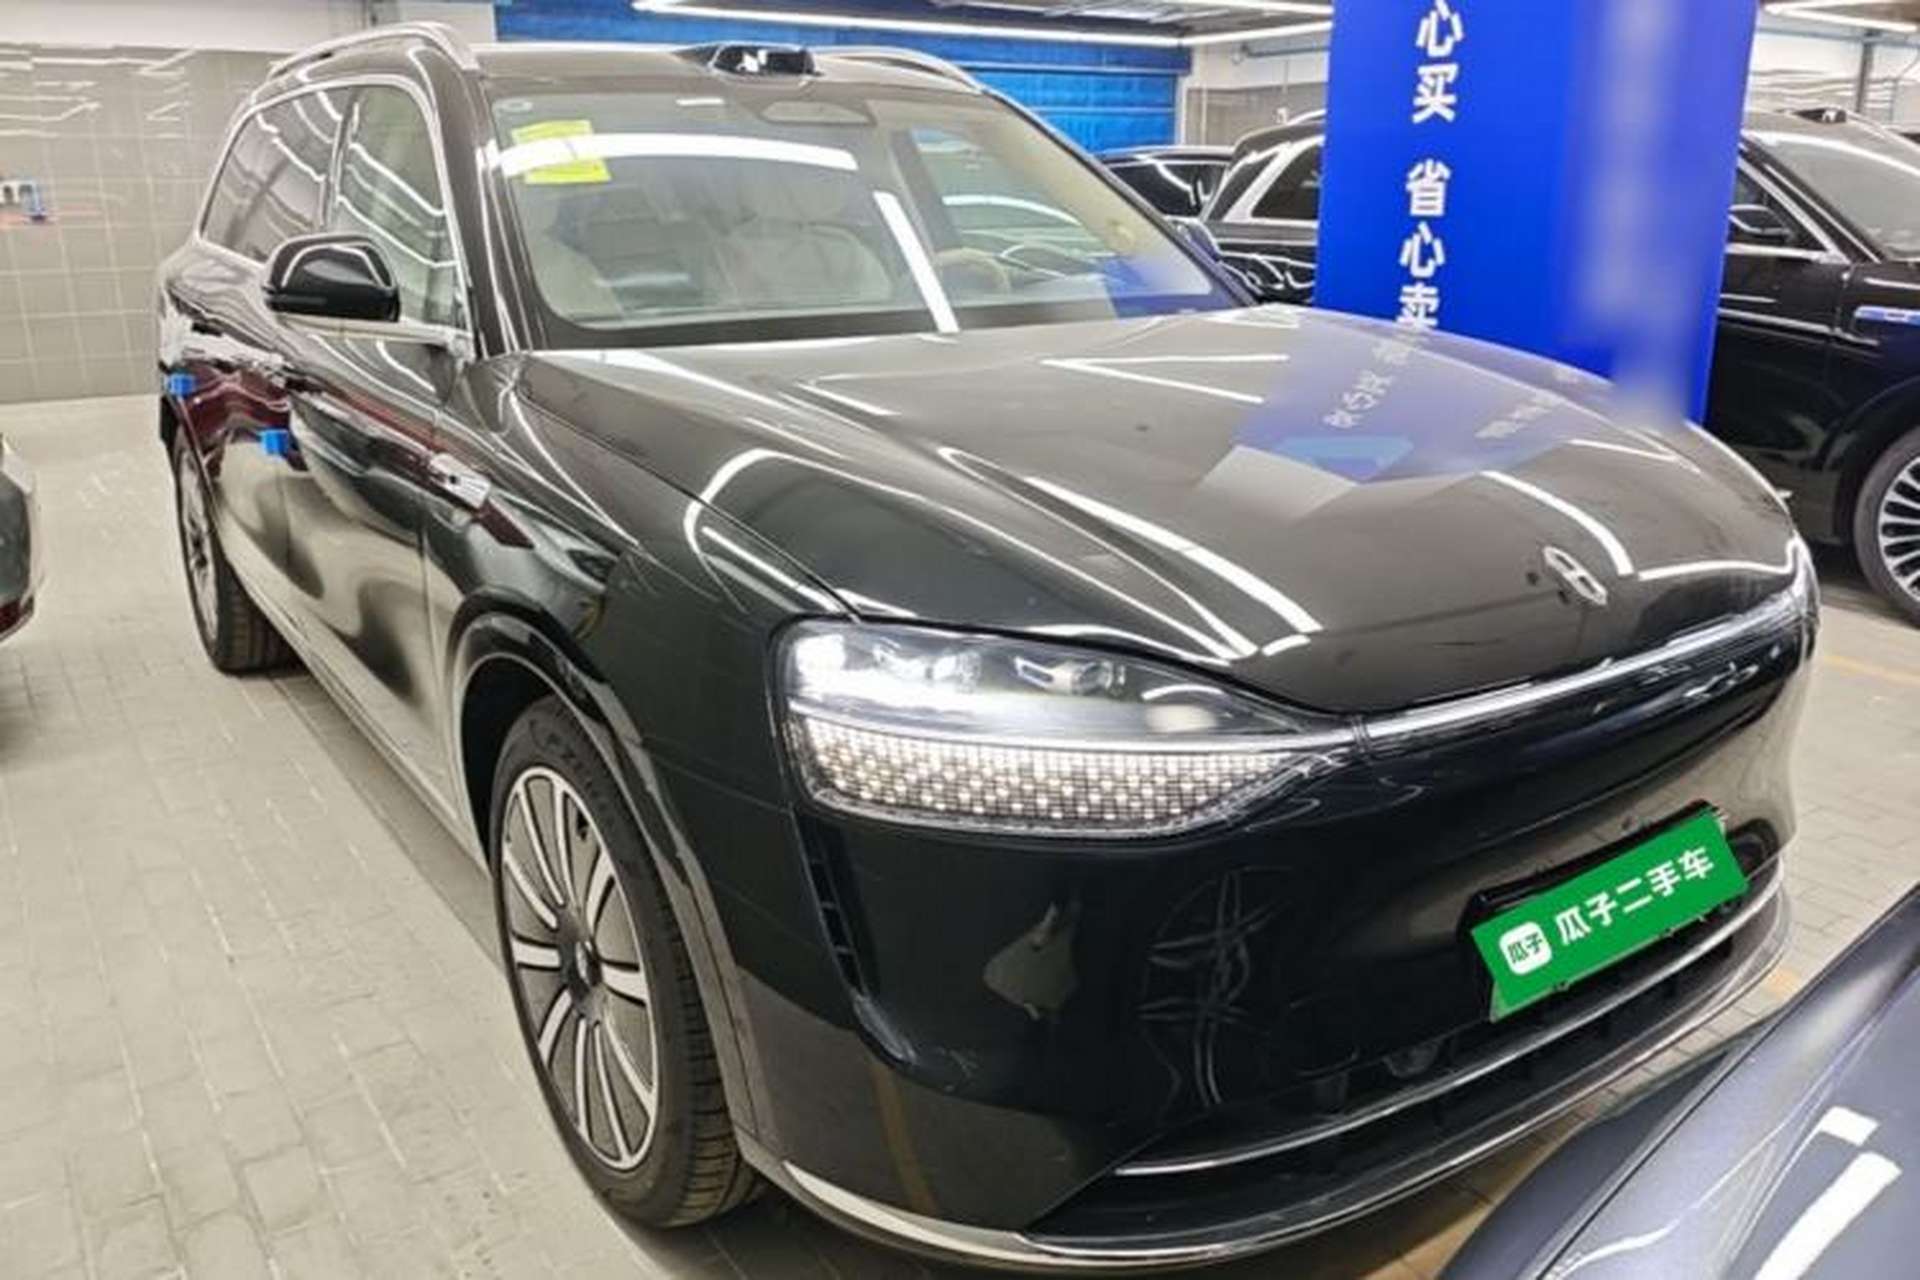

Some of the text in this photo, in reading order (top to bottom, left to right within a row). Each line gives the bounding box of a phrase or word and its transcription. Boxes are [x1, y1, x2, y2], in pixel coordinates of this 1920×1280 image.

[1395, 0, 1463, 328] 心买 省心卖
